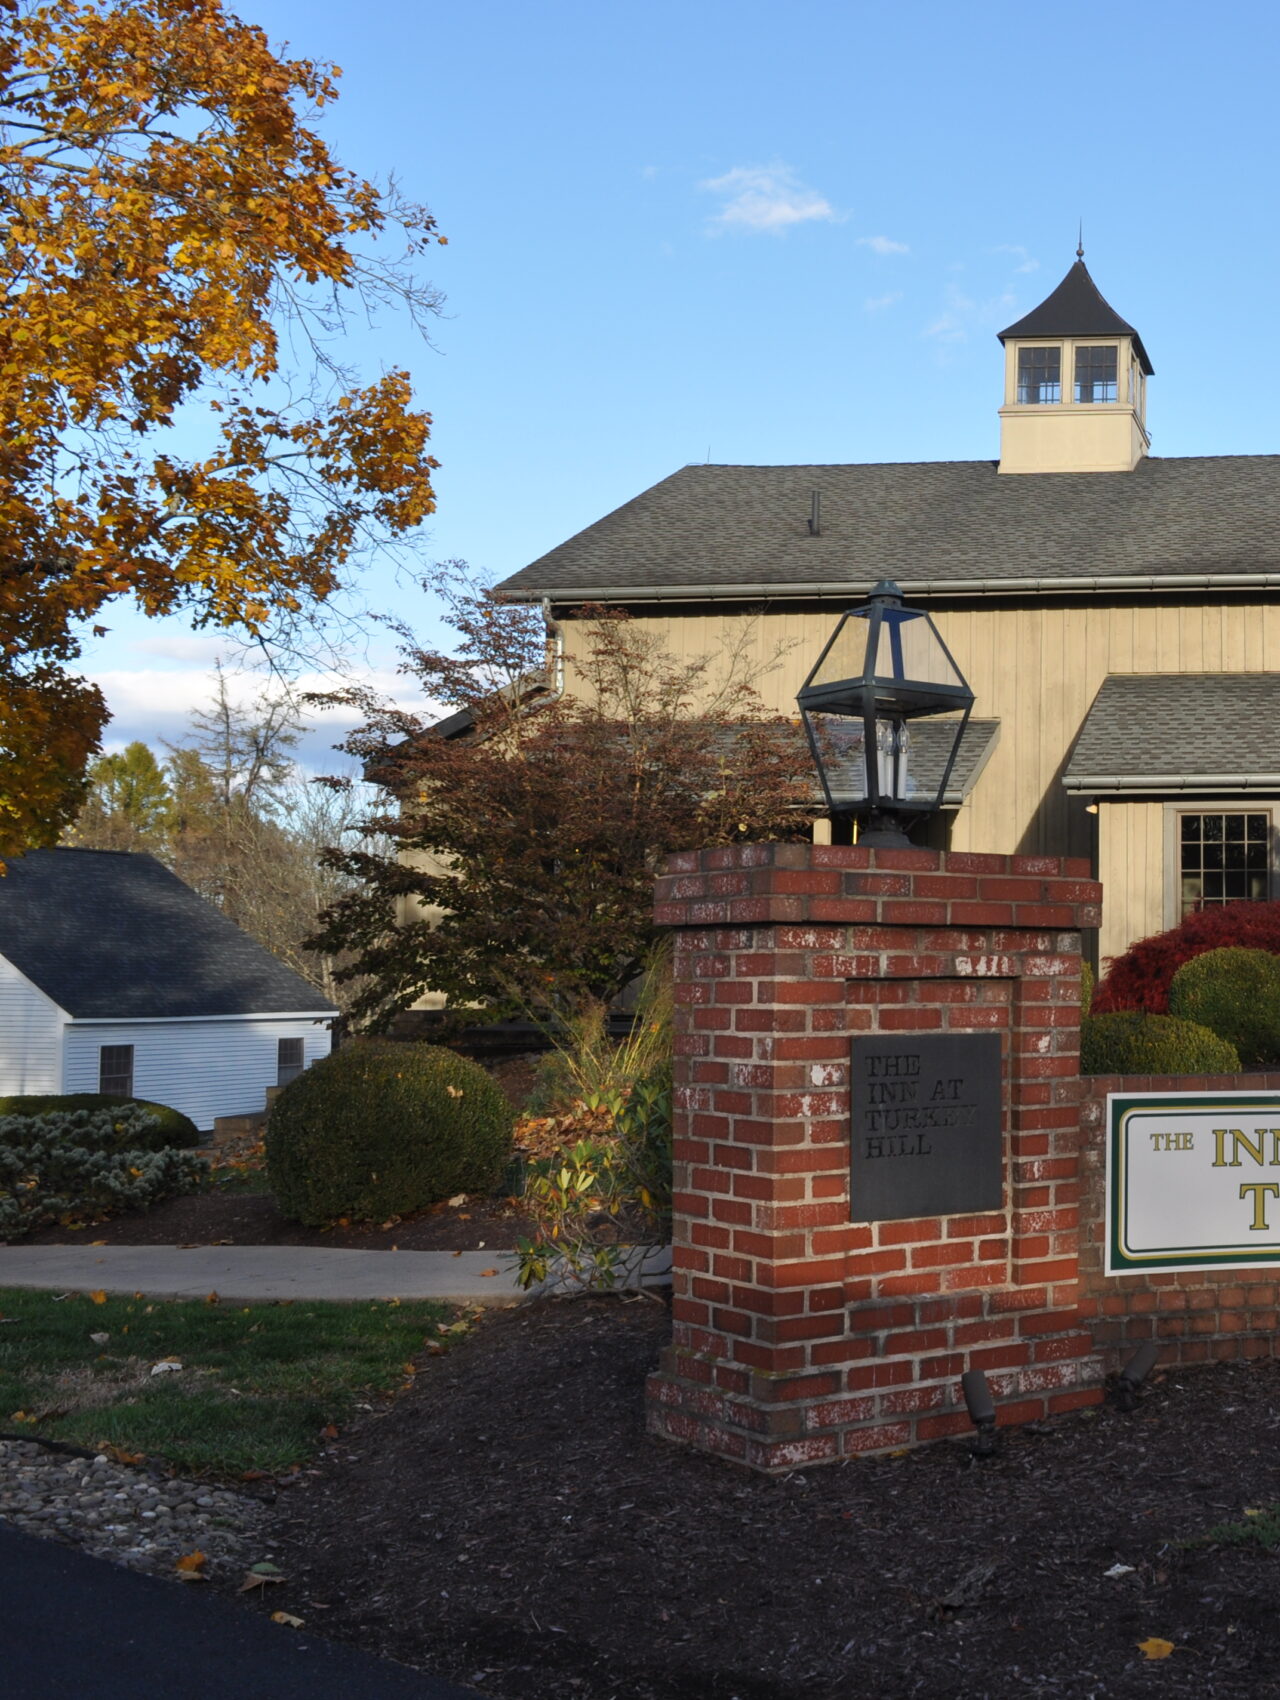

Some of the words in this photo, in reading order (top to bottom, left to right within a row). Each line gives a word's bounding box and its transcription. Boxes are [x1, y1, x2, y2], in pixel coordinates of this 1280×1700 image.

[864, 1055, 921, 1078] THE
[867, 1081, 919, 1104] INN
[929, 1079, 964, 1101] AT
[864, 1104, 978, 1132] TURKEY
[865, 1134, 933, 1159] HILL
[1150, 1132, 1194, 1151] THE
